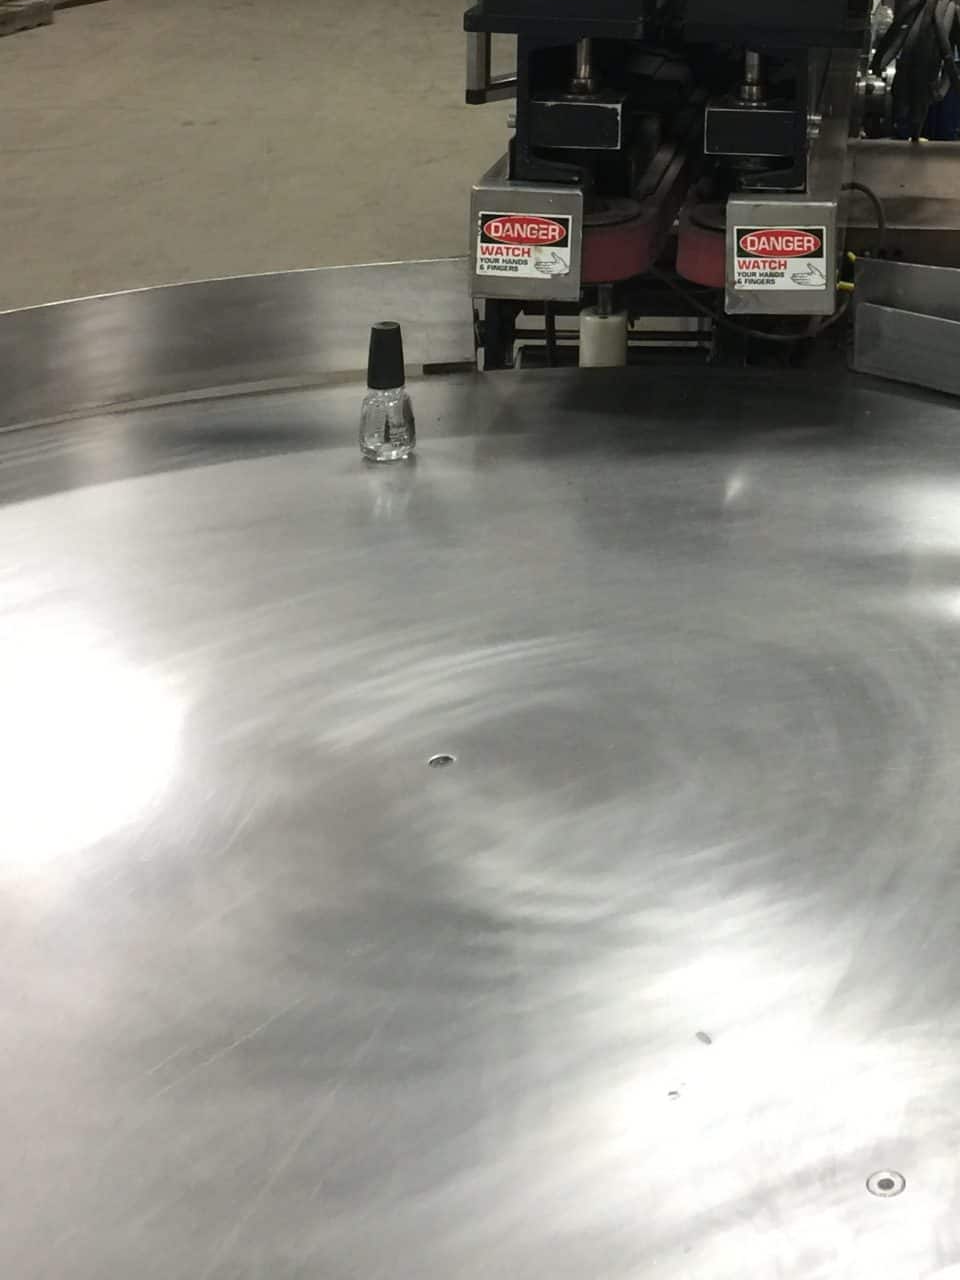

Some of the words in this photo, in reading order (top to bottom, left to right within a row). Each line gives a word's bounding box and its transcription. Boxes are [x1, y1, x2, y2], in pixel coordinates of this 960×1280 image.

[490, 222, 560, 240] DANGER
[746, 236, 815, 251] DANGER
[480, 246, 531, 257] WATCH
[738, 260, 787, 270] WATCH
